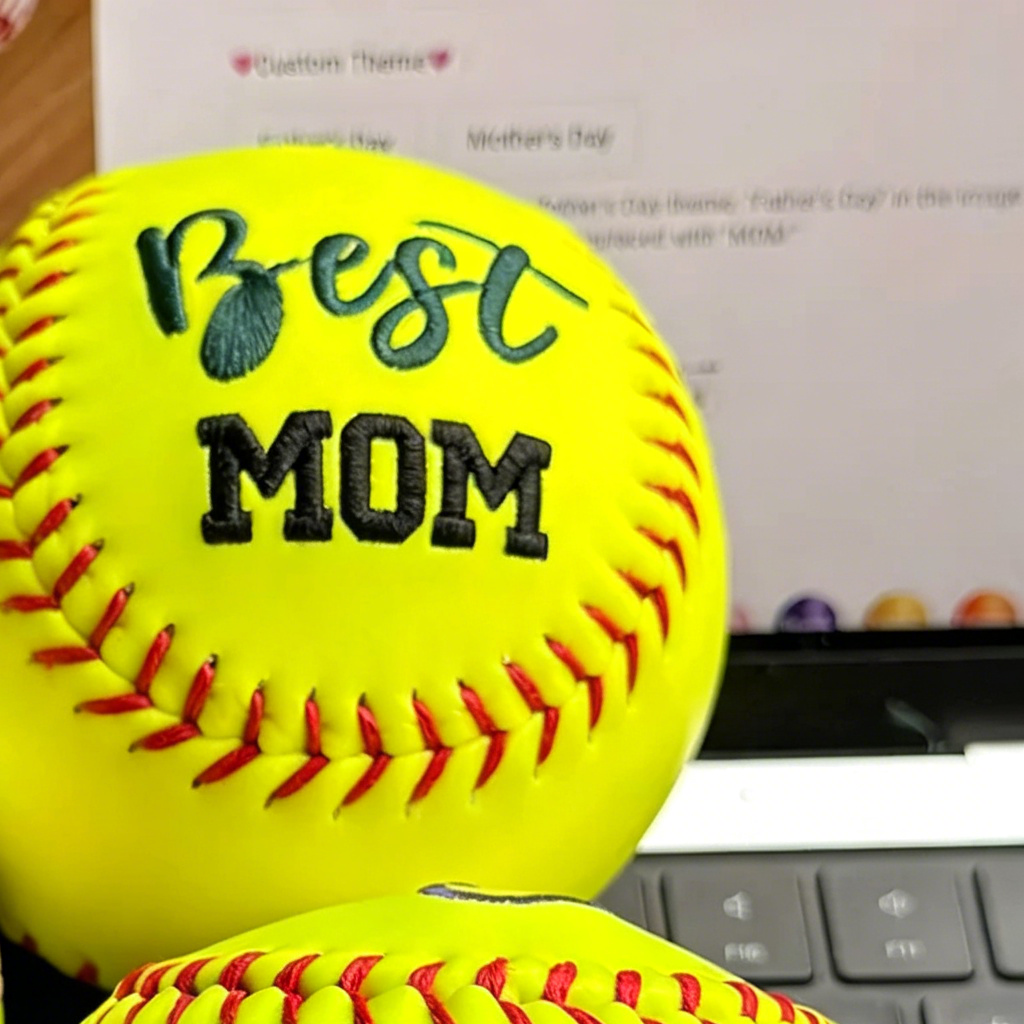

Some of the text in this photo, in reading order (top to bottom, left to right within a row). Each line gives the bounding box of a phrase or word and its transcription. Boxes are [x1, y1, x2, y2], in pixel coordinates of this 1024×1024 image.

[351, 49, 426, 75] Theme
[466, 122, 616, 155] Mother's Day
[134, 207, 591, 382] Best
[195, 409, 553, 560] MOM
